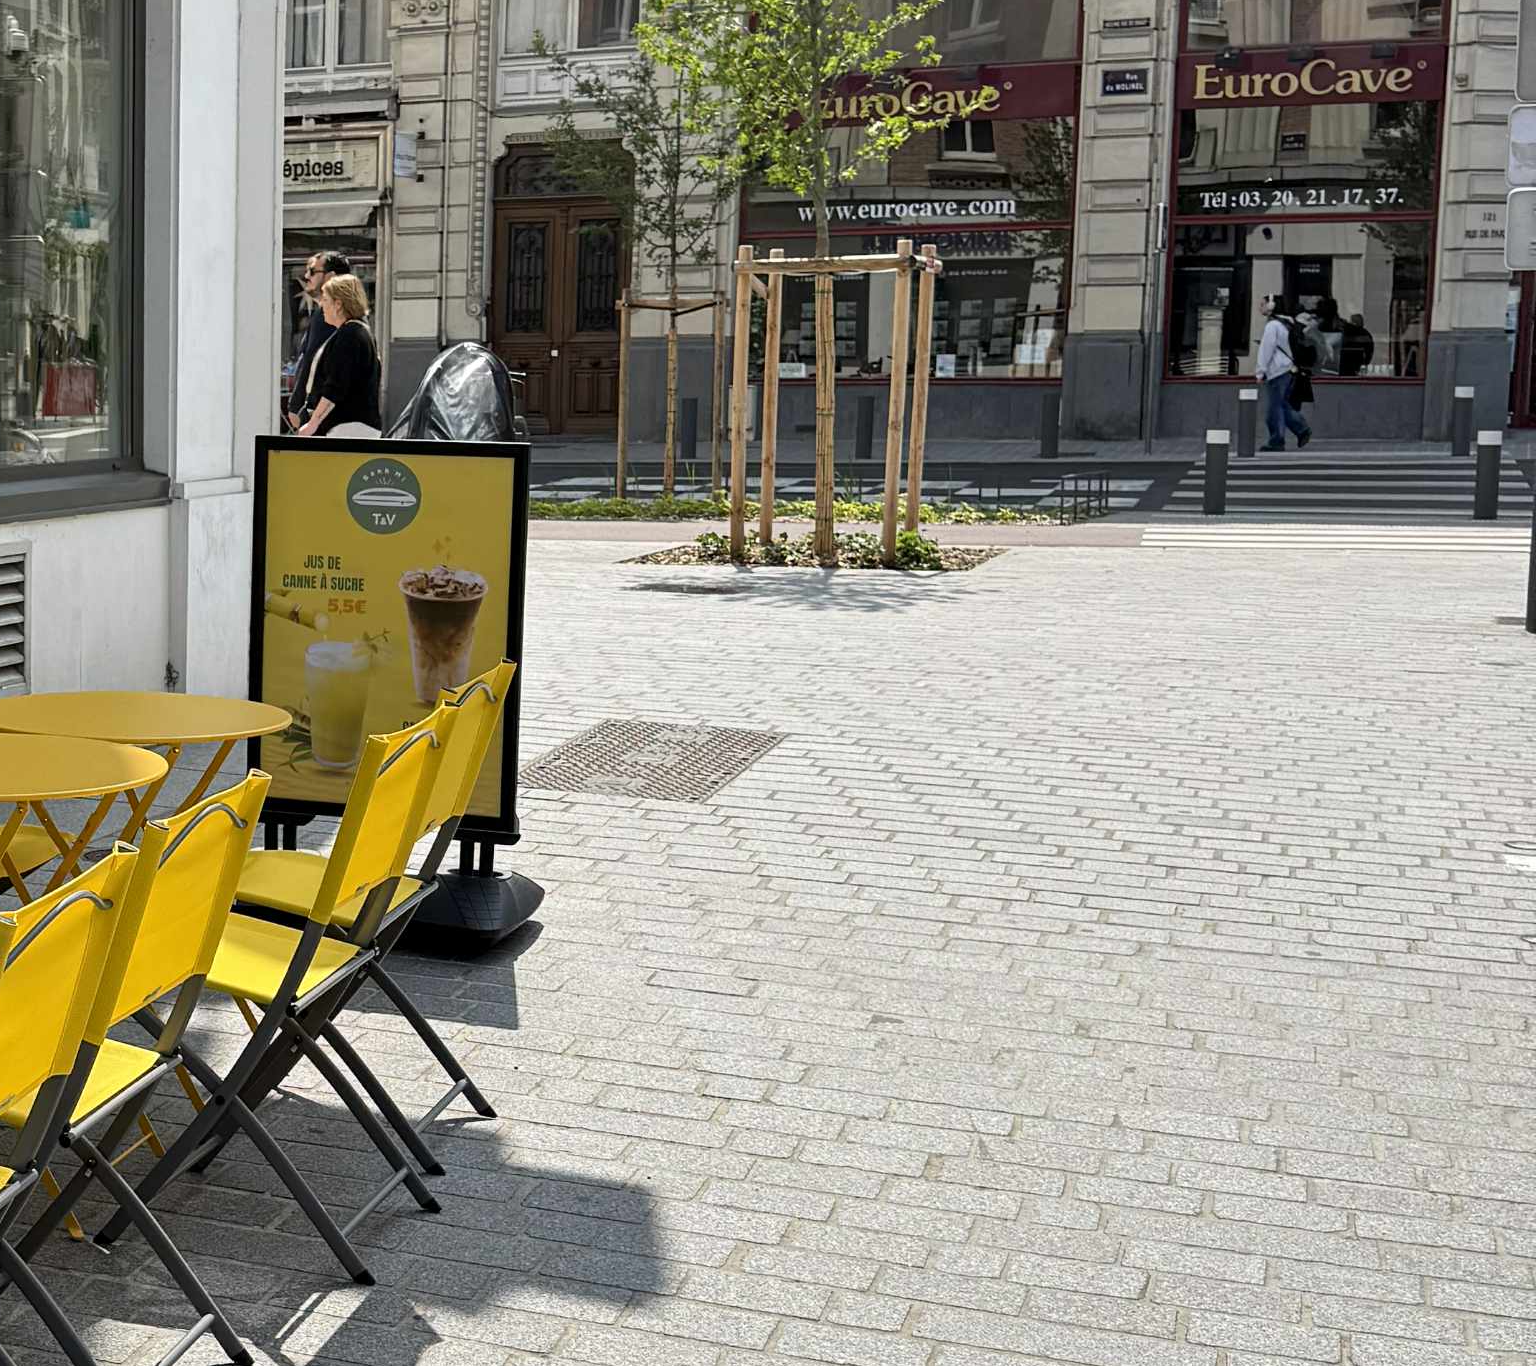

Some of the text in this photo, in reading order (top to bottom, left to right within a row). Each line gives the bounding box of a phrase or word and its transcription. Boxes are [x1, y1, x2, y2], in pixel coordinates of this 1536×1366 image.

[372, 513, 396, 525] T&V
[304, 555, 341, 570] JUS DE
[283, 573, 364, 591] CANNE À SUCRE
[328, 598, 367, 615] 5,5€
